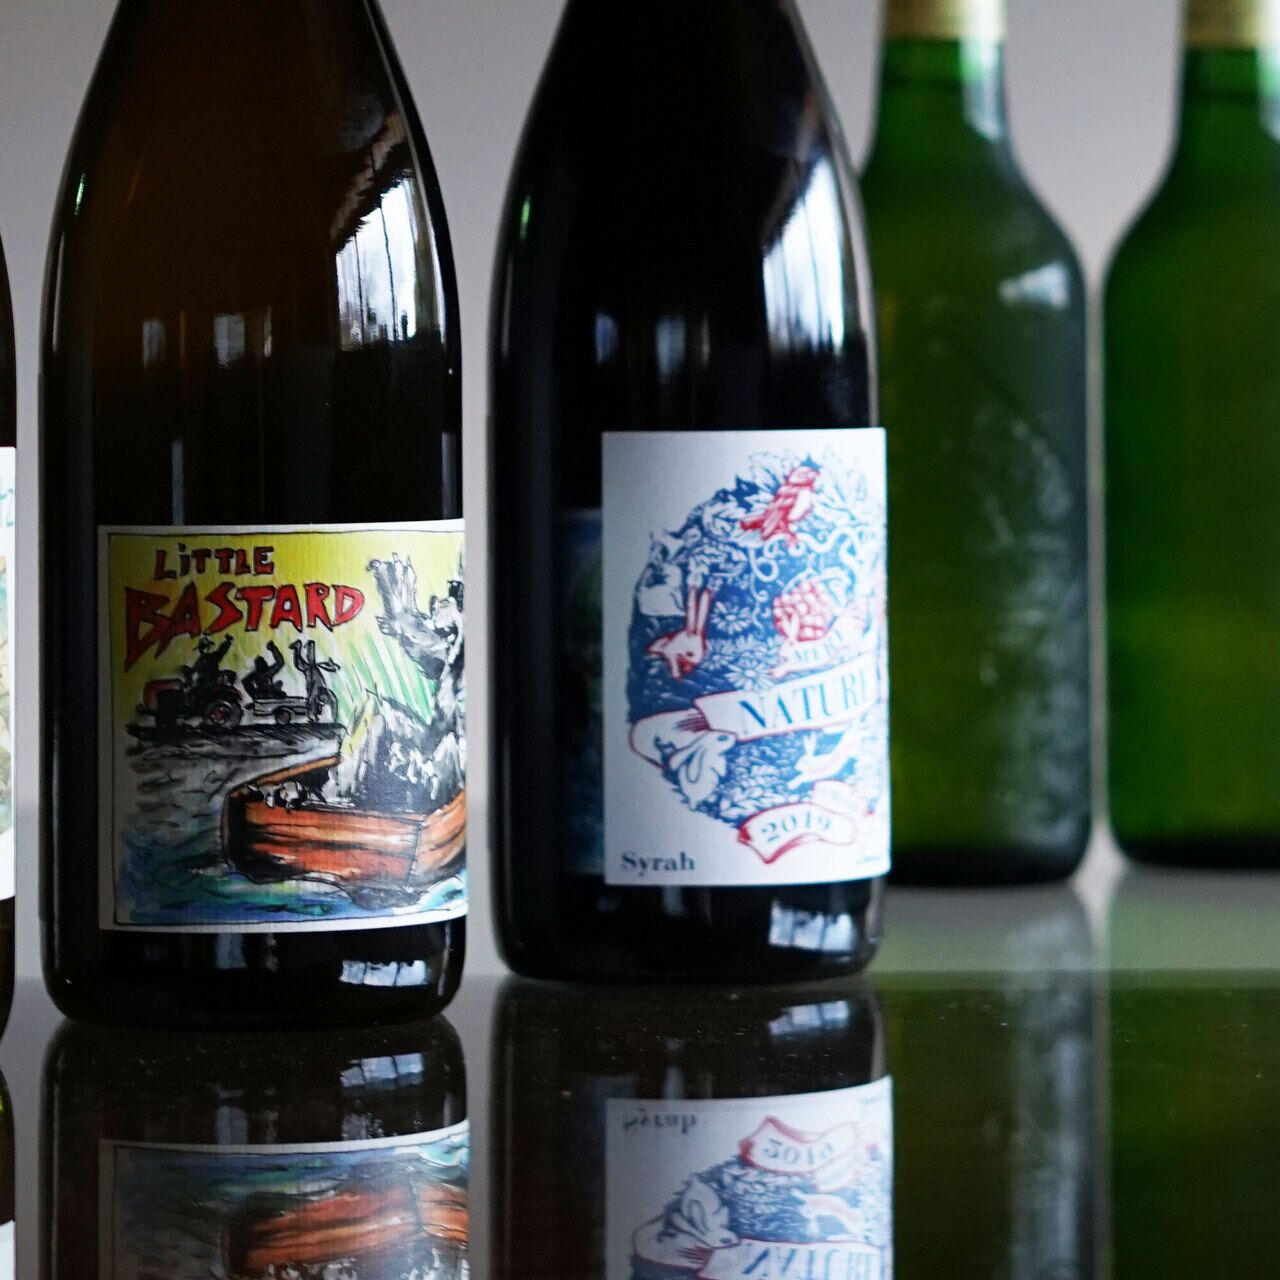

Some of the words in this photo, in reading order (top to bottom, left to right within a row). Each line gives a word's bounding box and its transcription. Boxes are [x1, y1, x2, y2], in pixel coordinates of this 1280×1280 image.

[124, 581, 365, 672] BASTARD
[762, 810, 830, 842] 2019
[622, 850, 695, 877] Syrah
